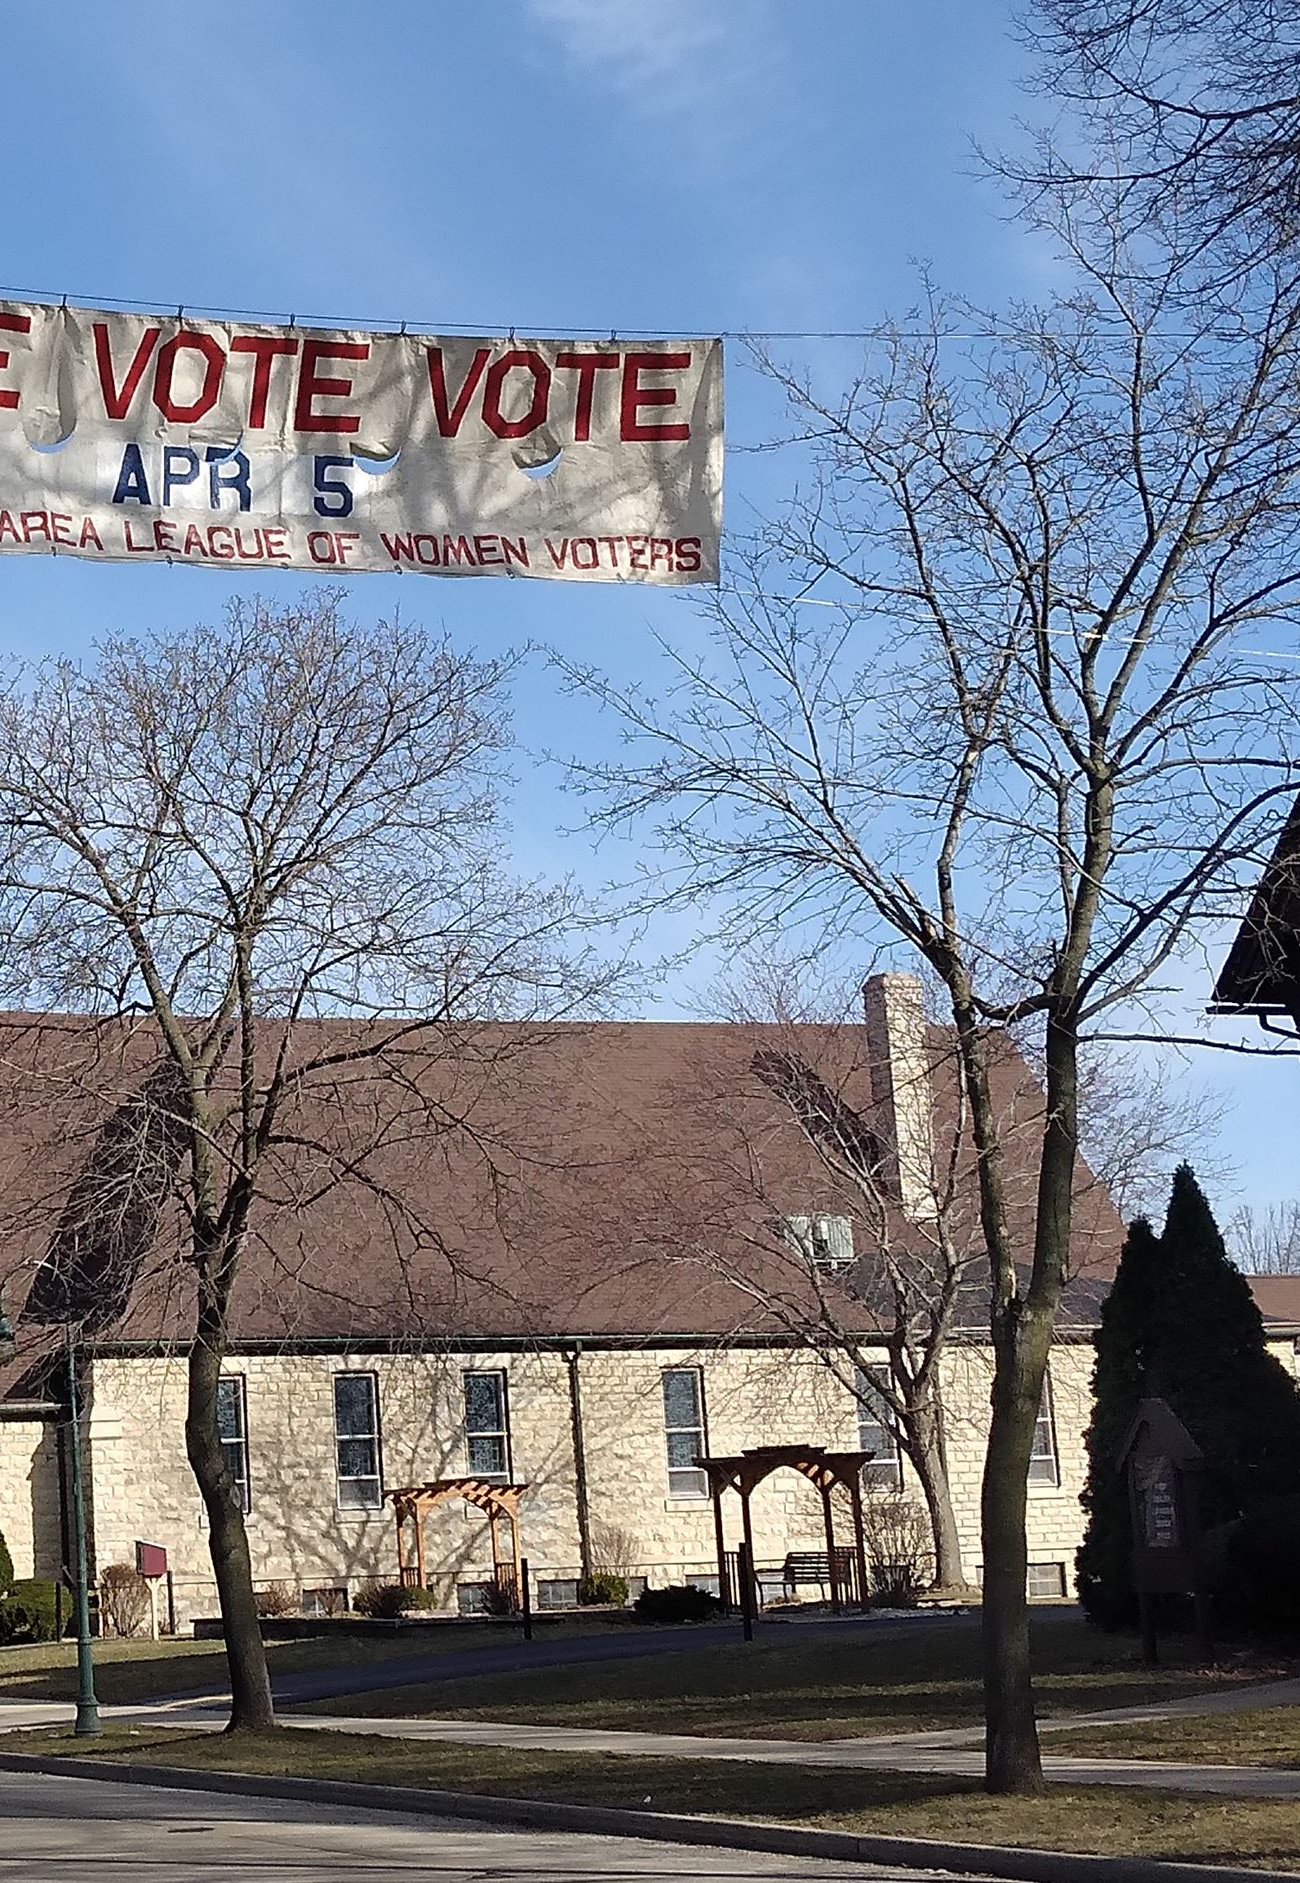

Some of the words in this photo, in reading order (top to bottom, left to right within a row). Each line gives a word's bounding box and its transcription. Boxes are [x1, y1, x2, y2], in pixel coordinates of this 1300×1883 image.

[93, 323, 370, 434] VOTE
[427, 347, 691, 443] VOTE
[112, 443, 252, 512] APR
[313, 455, 354, 518] 5
[124, 520, 291, 560] LEAGUE
[307, 531, 360, 564] OF
[380, 533, 530, 568] WOMEN
[544, 536, 702, 573] VOTERS
